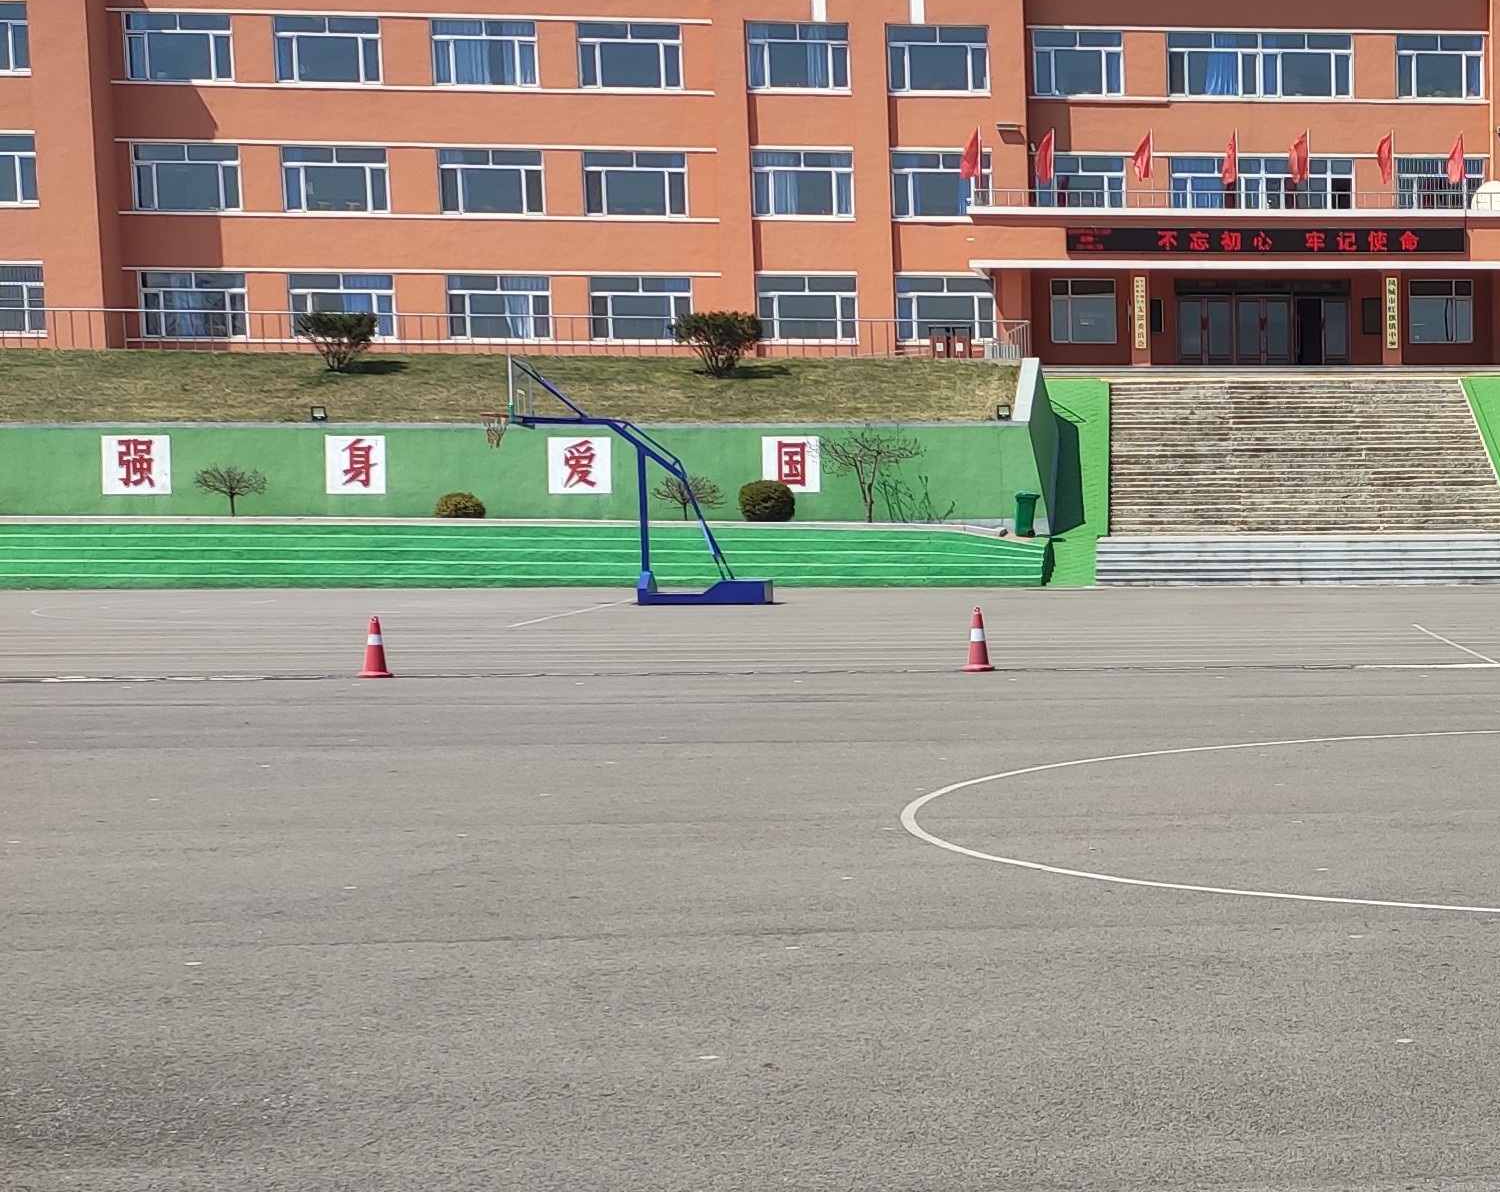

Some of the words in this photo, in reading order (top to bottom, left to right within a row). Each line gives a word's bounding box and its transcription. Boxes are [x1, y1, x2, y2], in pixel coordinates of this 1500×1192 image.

[1157, 230, 1273, 252] 不忘初心
[1304, 230, 1420, 252] 牢记使命
[116, 439, 807, 487] 强身爱国
